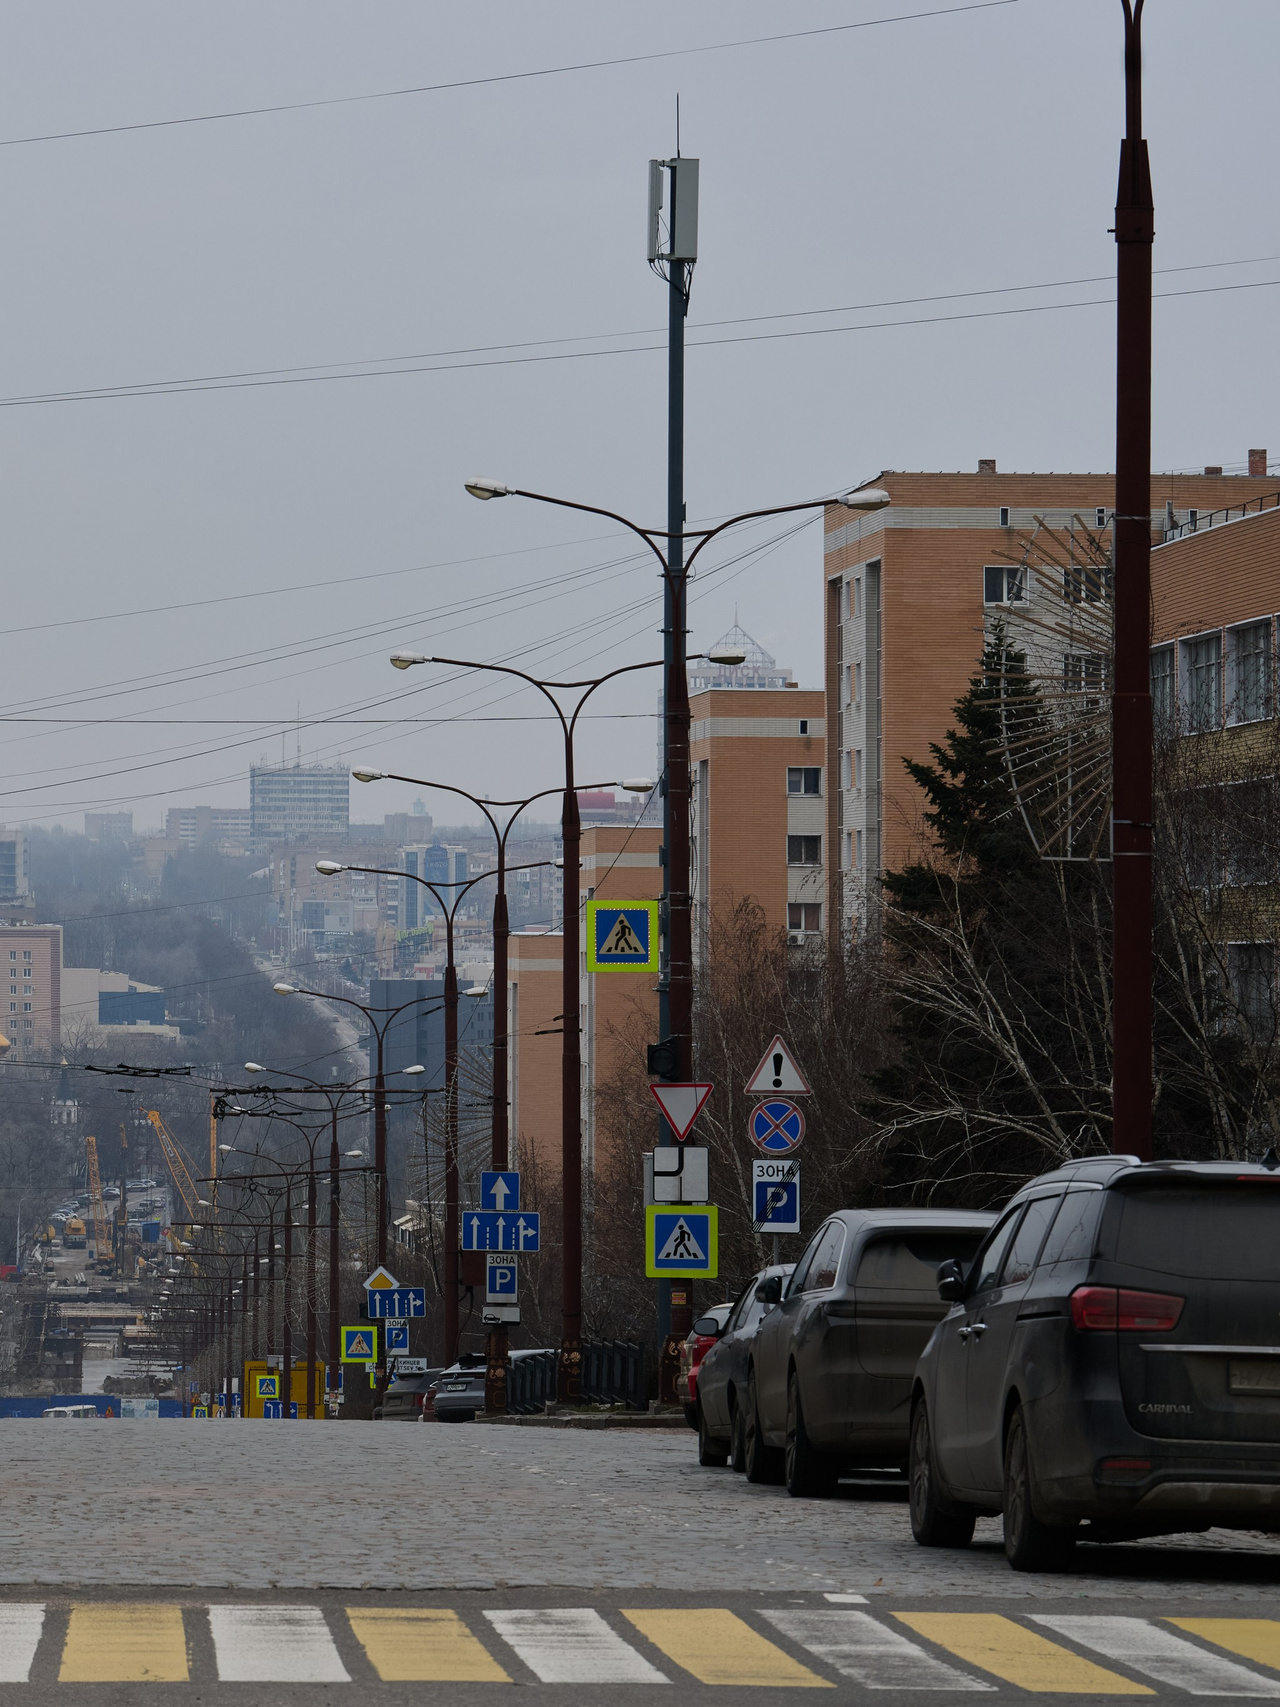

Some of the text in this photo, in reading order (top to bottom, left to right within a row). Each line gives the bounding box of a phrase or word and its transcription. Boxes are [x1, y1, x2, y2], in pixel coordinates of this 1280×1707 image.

[756, 1165, 795, 1178] ЗОНА
[766, 1187, 788, 1219] P
[489, 1256, 515, 1265] ЗОНА
[496, 1268, 511, 1291] P
[392, 1330, 404, 1346] P
[1138, 1403, 1194, 1414] CARNIVAL
